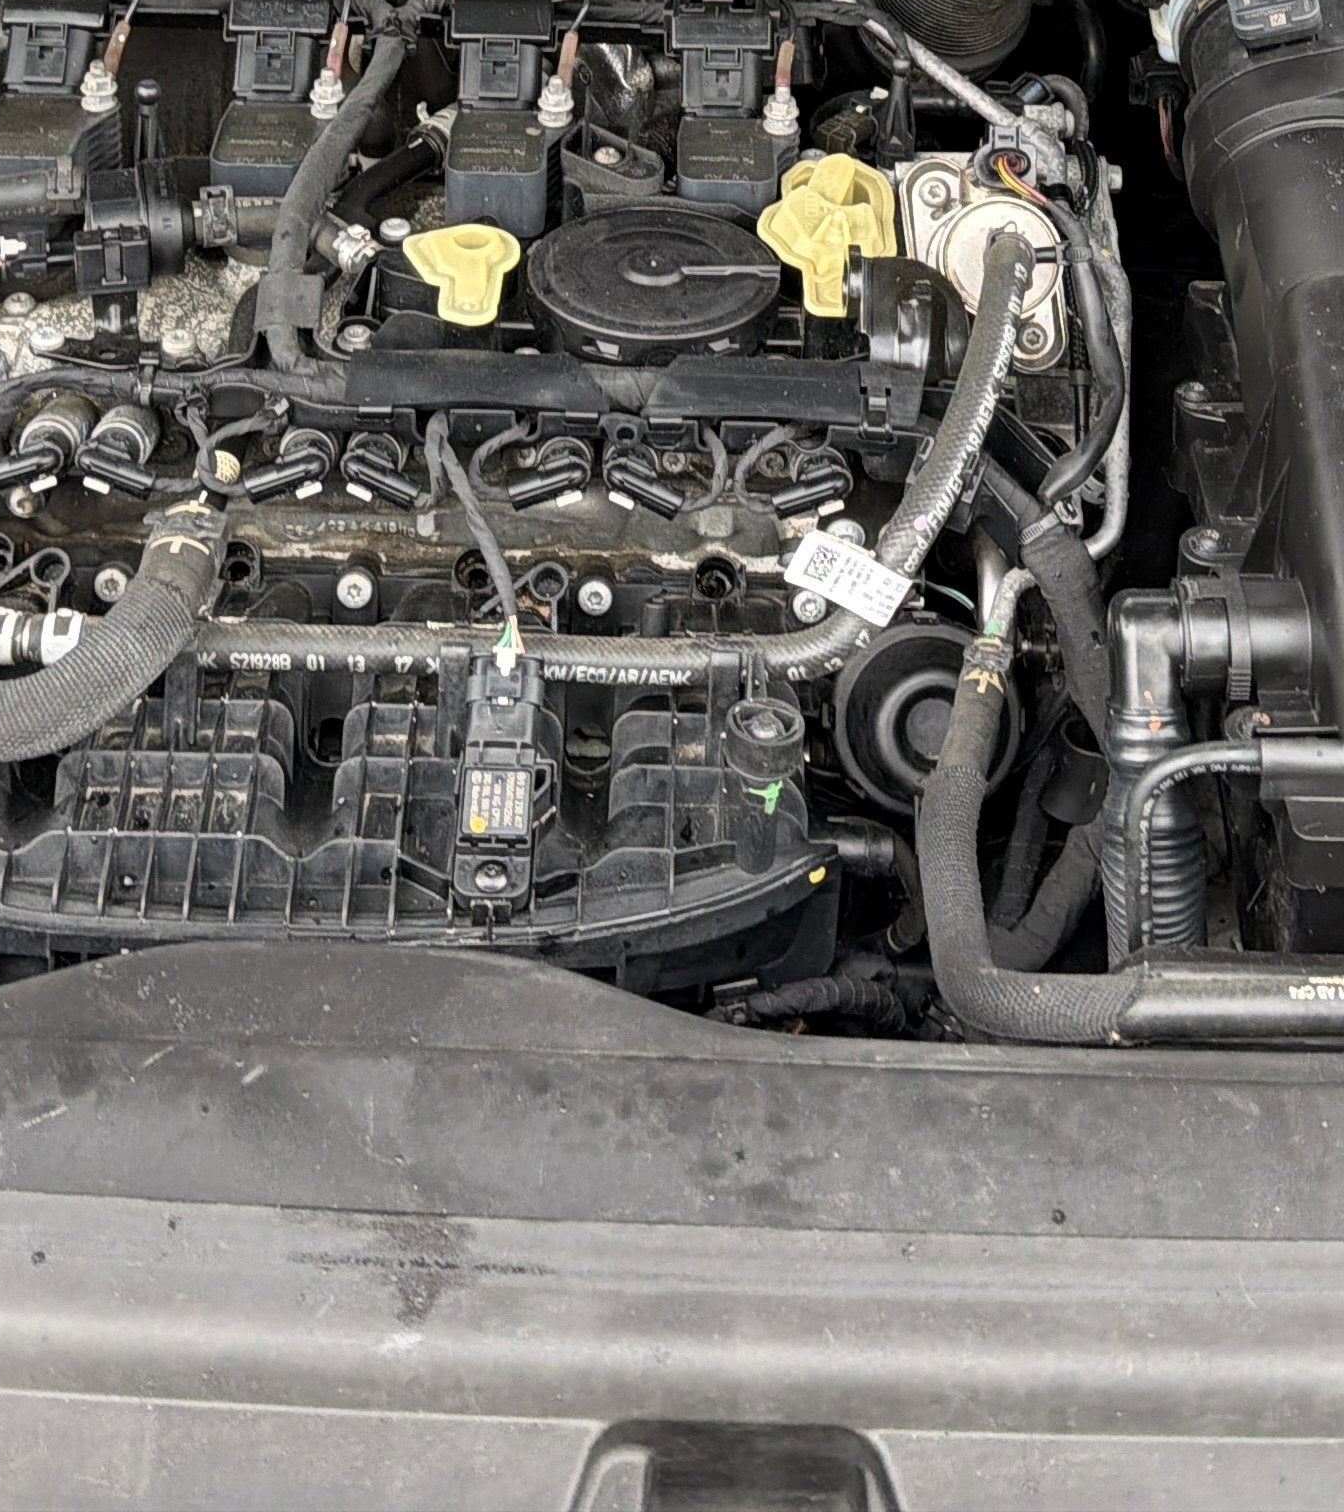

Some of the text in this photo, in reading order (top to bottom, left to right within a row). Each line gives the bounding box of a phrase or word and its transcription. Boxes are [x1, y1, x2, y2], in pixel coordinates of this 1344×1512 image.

[1008, 294, 1022, 316] 01
[229, 651, 292, 672] S21928B
[306, 653, 326, 672] 01
[347, 654, 366, 673] 13
[394, 655, 414, 674] 17
